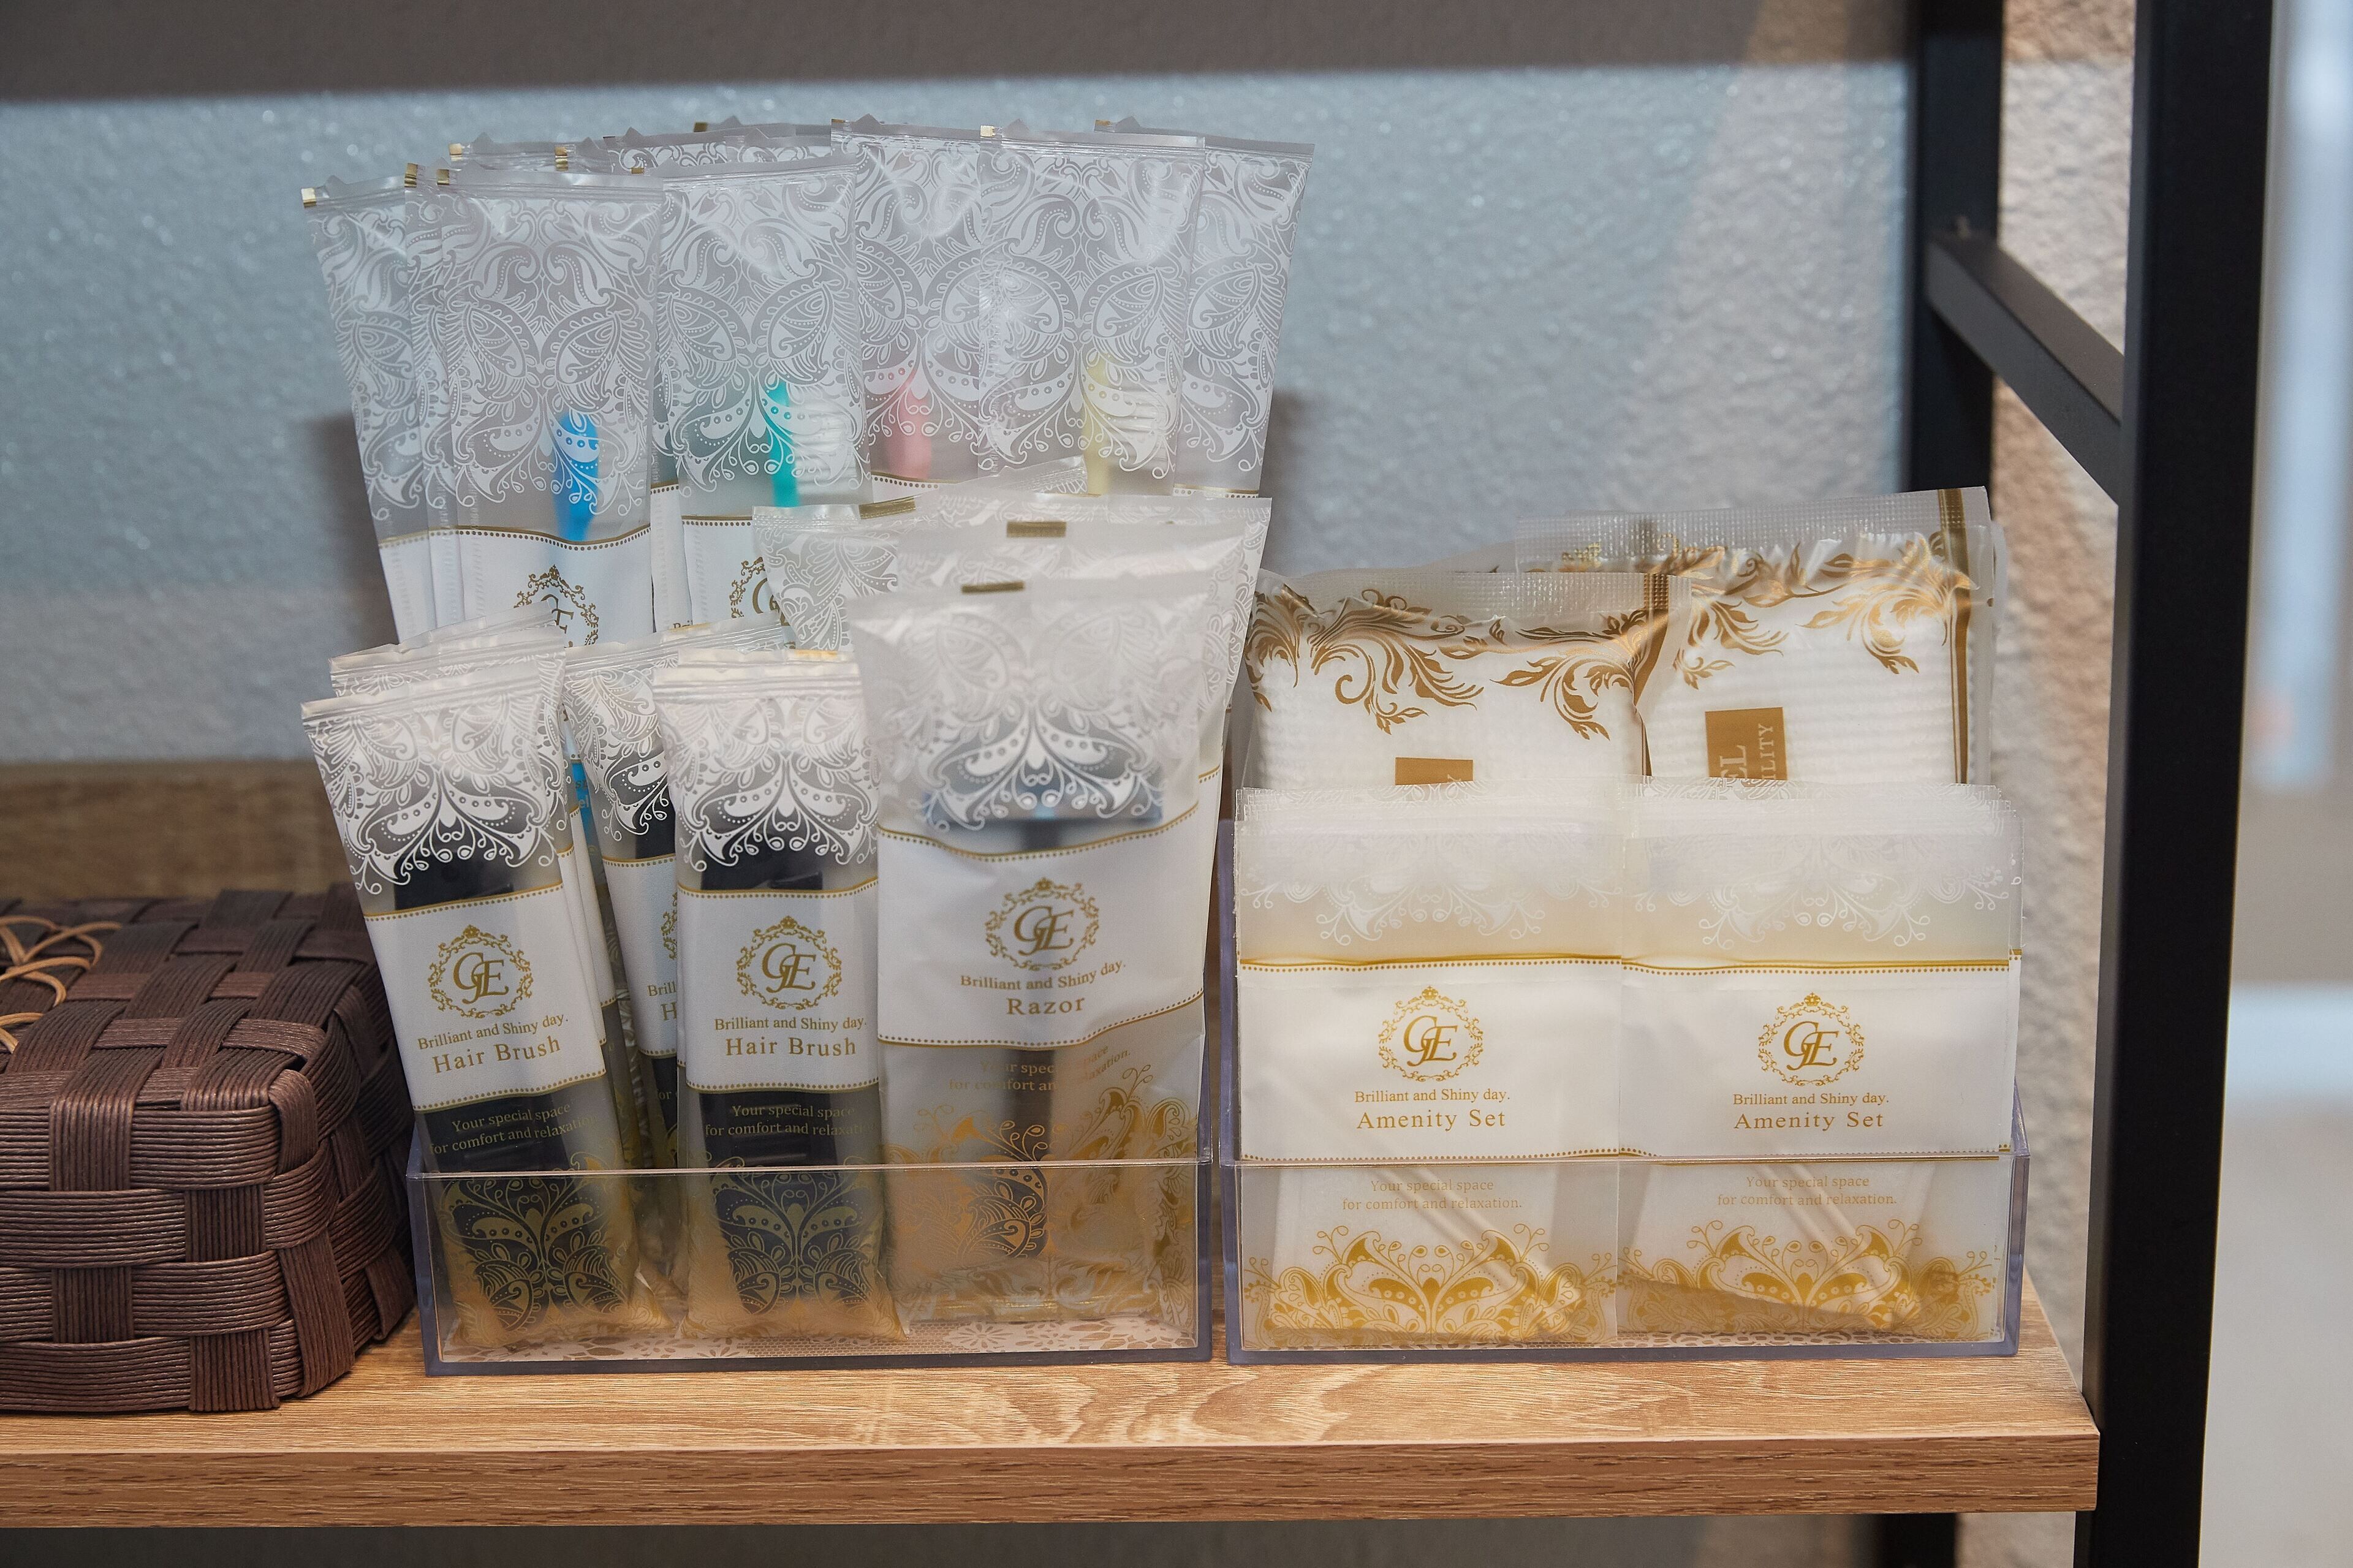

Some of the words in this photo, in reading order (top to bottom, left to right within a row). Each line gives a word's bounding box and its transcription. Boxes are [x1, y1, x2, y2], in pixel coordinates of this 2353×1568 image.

[960, 975, 1021, 990] Brilliant
[1026, 977, 1053, 990] and
[1058, 970, 1096, 988] Shiny
[1101, 960, 1126, 976] day.
[1006, 997, 1085, 1015] Razor
[417, 1029, 472, 1050] Brilliant
[476, 1023, 499, 1038] and
[502, 1021, 538, 1034] Shiny
[542, 1013, 569, 1027] day.
[714, 1017, 769, 1031] Brilliant
[773, 1017, 797, 1029] and
[801, 1017, 838, 1033] Shiny
[843, 1017, 867, 1031] day.
[432, 1048, 485, 1073] Hair
[494, 1035, 561, 1061] Brush
[726, 1036, 778, 1056] Hair
[788, 1037, 857, 1056] Brush
[1354, 1090, 1409, 1102] Brilliant
[1413, 1089, 1436, 1101] and
[1441, 1088, 1479, 1103] Shiny
[1483, 1088, 1510, 1102] day.
[1733, 1093, 1787, 1105] Brilliant
[1792, 1093, 1816, 1105] and
[1820, 1093, 1859, 1106] Shiny
[1862, 1092, 1889, 1106] day.
[452, 1117, 485, 1132] Your
[488, 1109, 532, 1127] special
[536, 1104, 570, 1123] space
[732, 1105, 765, 1117] Your
[768, 1105, 814, 1118] special
[1356, 1109, 1457, 1131] Amenity
[1469, 1108, 1506, 1127] Set
[705, 1124, 724, 1137] for
[728, 1122, 782, 1136] comfort
[785, 1123, 809, 1134] and
[1733, 1112, 1835, 1131] Amenity
[1847, 1112, 1884, 1127] Set
[452, 1132, 506, 1151] comfort
[508, 1126, 532, 1140] and
[1371, 1180, 1402, 1191] Your
[1406, 1179, 1452, 1193] special
[1456, 1181, 1494, 1194] space
[1746, 1176, 1778, 1187] Your
[1782, 1176, 1828, 1191] special
[1832, 1177, 1870, 1191] space
[1343, 1198, 1362, 1210] for
[1365, 1197, 1419, 1210] comfort
[1422, 1197, 1447, 1209] and
[1451, 1197, 1522, 1208] relaxation.
[1718, 1194, 1737, 1206] for
[1740, 1194, 1794, 1206] comfort
[1797, 1194, 1822, 1205] and
[1826, 1193, 1897, 1205] relaxation.
